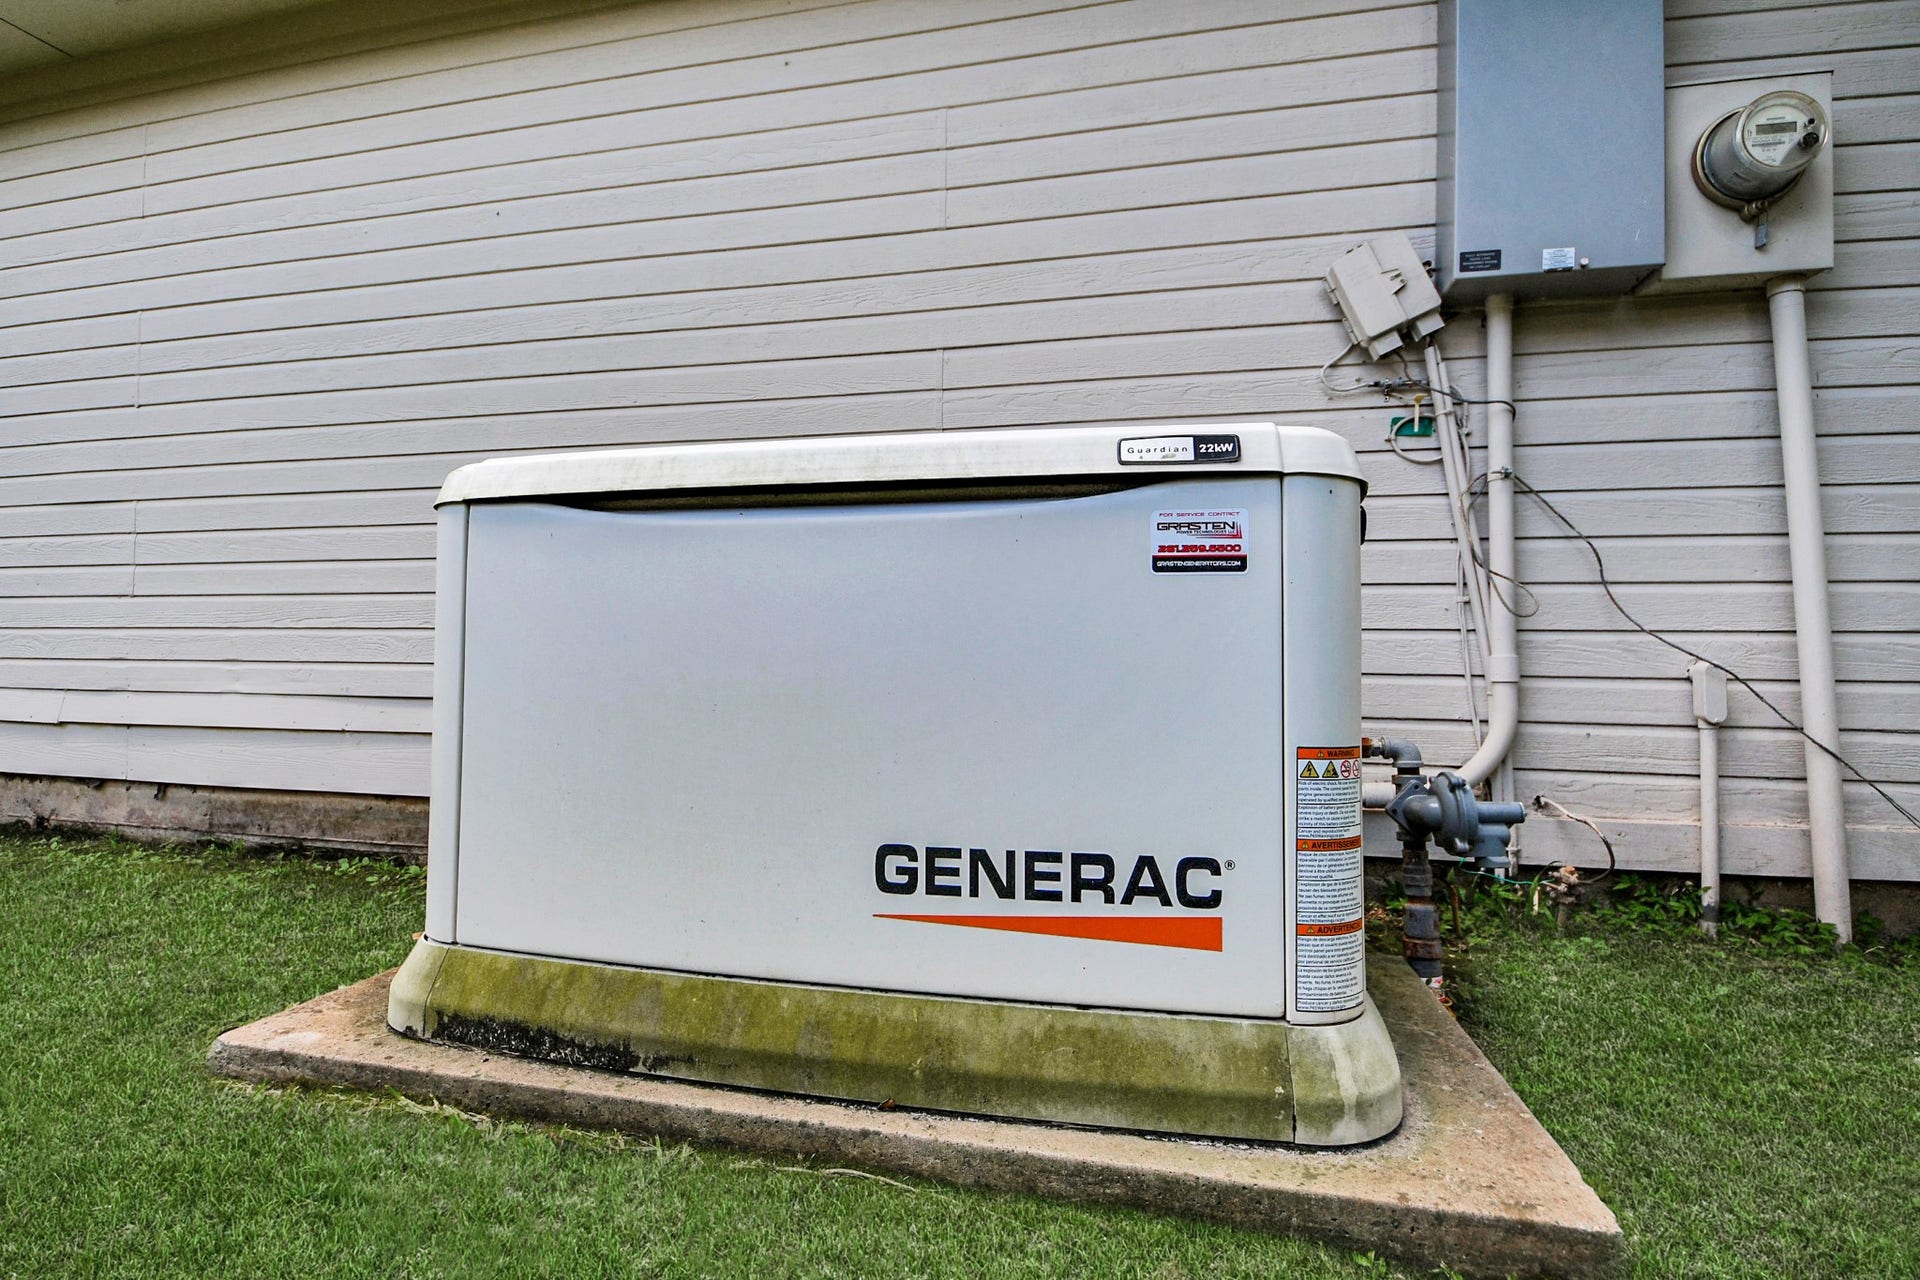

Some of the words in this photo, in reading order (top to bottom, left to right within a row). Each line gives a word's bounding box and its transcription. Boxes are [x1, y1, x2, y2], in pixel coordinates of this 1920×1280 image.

[1127, 446, 1188, 454] Guardian
[1199, 443, 1234, 453] 22kW
[1157, 521, 1235, 531] GRASTEN
